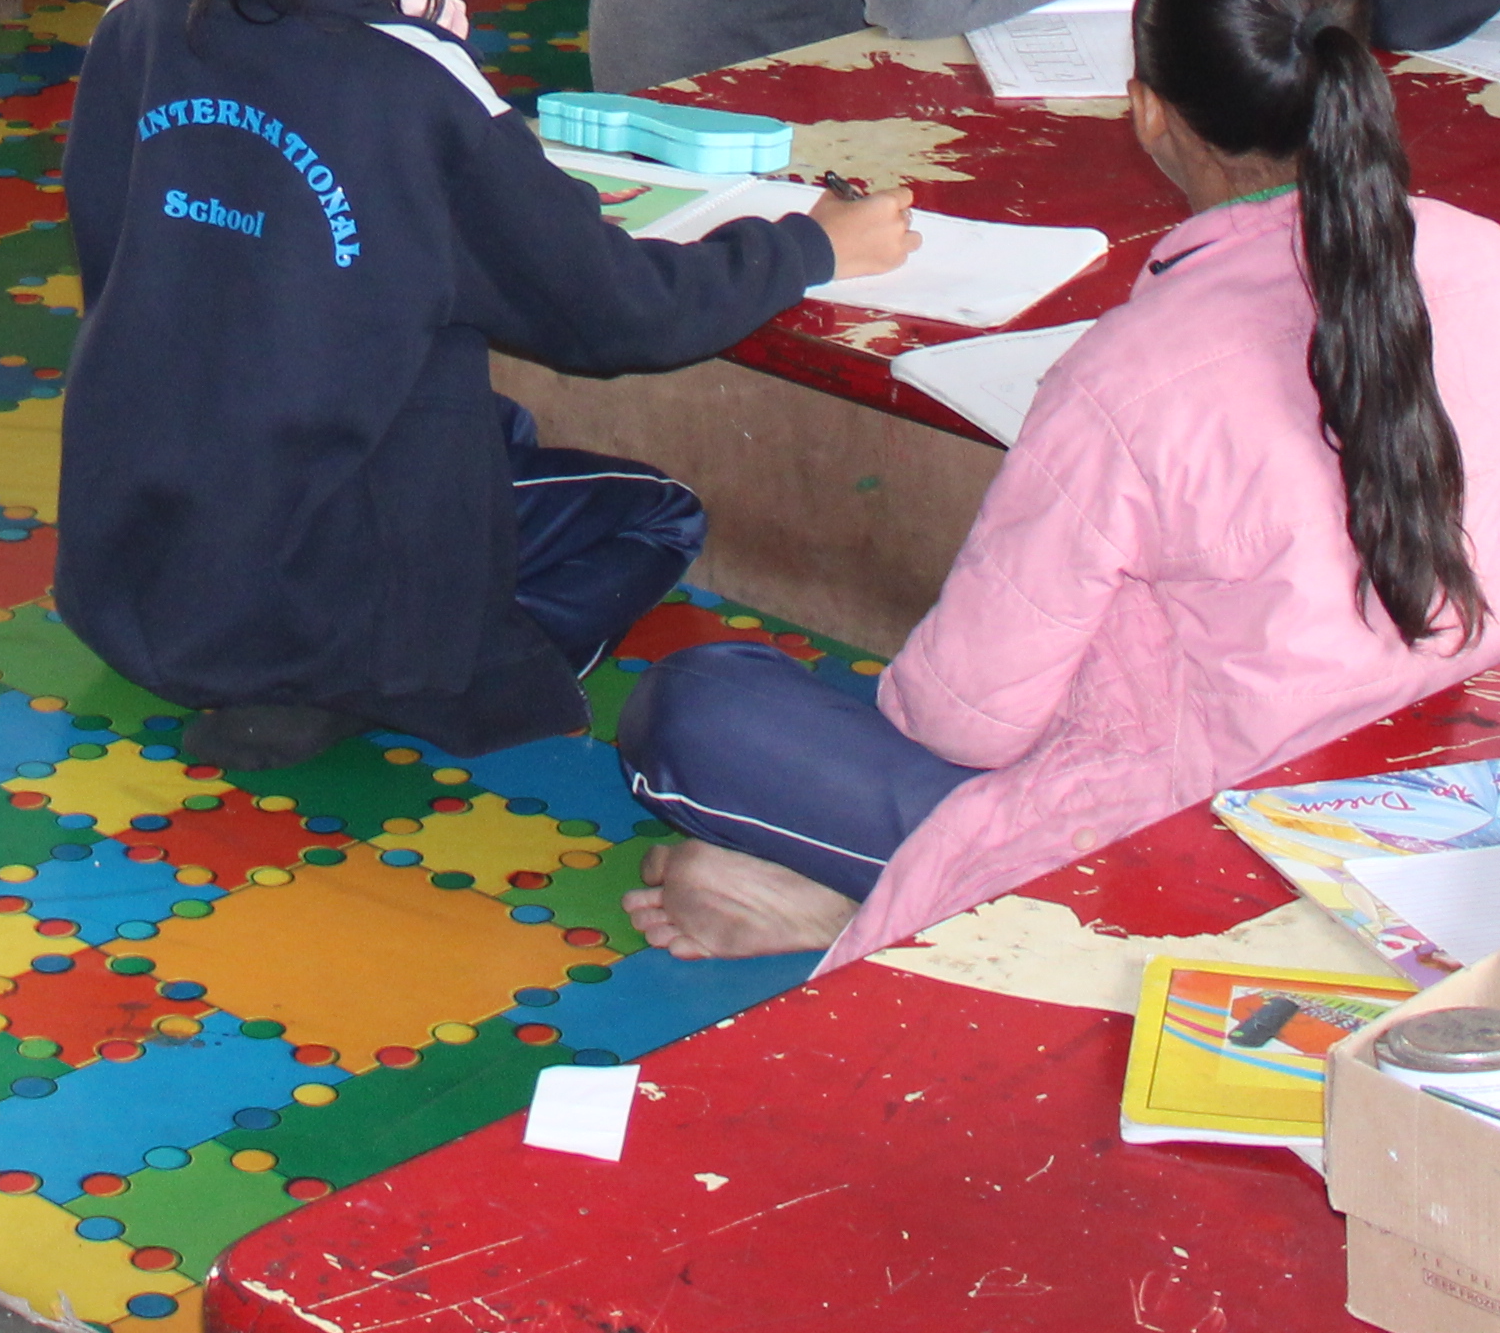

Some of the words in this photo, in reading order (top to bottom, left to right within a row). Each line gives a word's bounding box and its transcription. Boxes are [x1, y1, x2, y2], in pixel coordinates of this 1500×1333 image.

[137, 97, 361, 268] INTERNATIONAL
[163, 189, 266, 238] School
[1287, 790, 1416, 813] Dream
[1431, 784, 1475, 802] to
